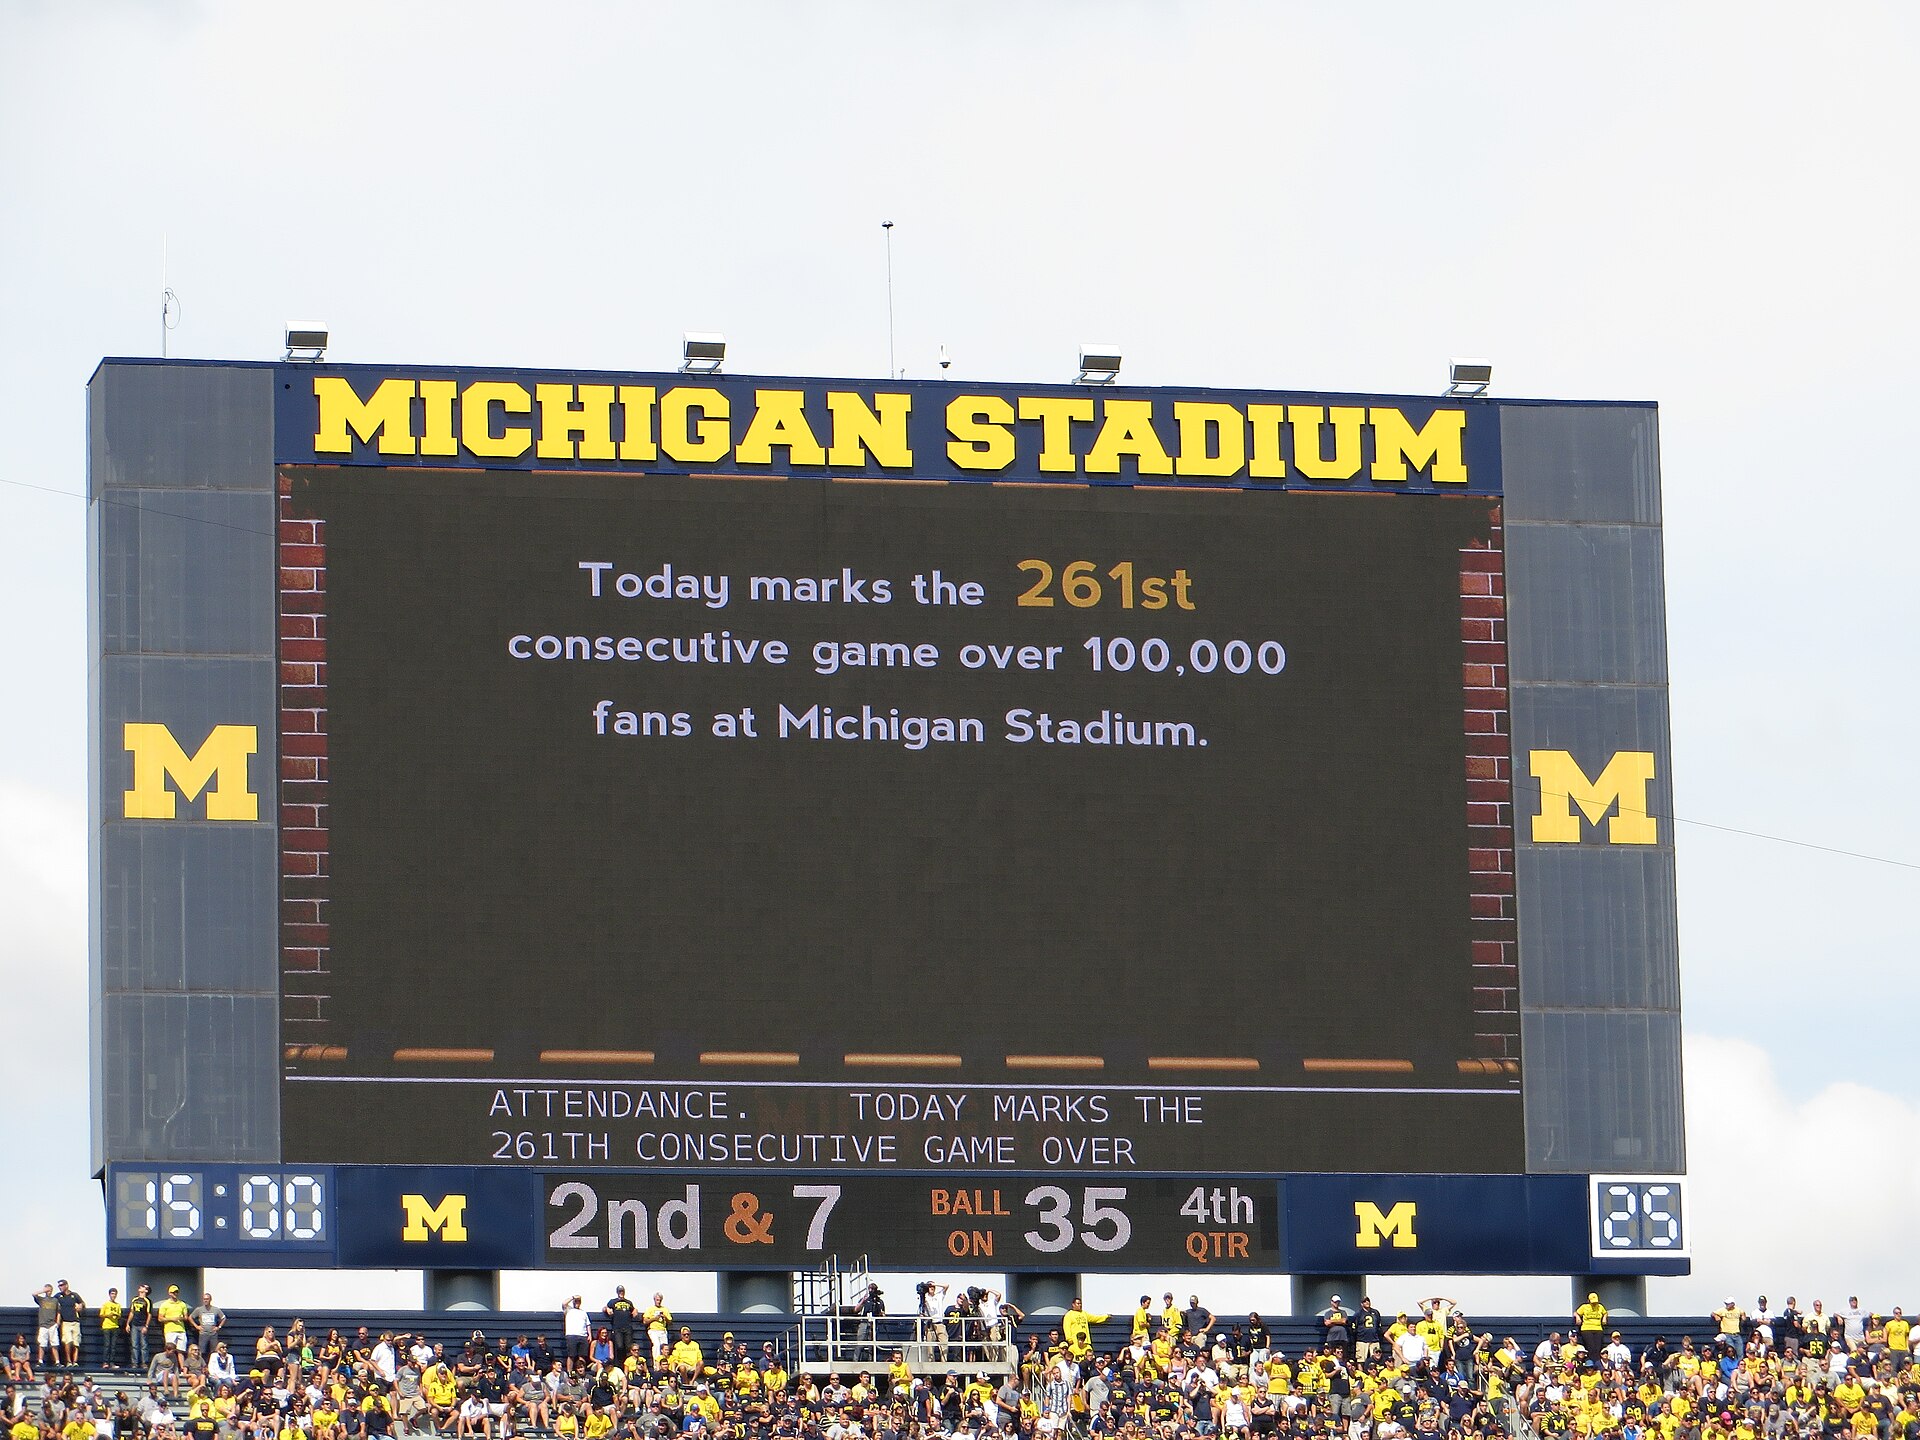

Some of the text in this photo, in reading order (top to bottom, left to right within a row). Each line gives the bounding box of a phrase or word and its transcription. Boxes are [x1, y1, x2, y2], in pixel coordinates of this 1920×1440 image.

[314, 378, 1467, 482] MICHIGAN STADIUM
[579, 560, 1195, 610] Today marks the 261st
[509, 631, 1285, 676] consecutive game over 100,000
[593, 700, 1207, 749] fans at Michigan Stadium.
[124, 723, 257, 820] M
[1530, 750, 1657, 844] M
[490, 1090, 1202, 1123] ATTENDANCE. TODAY MARKS THE
[492, 1132, 1135, 1164] 261TH CONSECUTIVE GAME OVER
[147, 1175, 321, 1238] 15:00
[403, 1195, 466, 1241] M
[550, 1182, 840, 1250] 2nd & 7
[932, 1190, 1009, 1215] BALL
[1024, 1186, 1130, 1252] 35
[1181, 1187, 1253, 1223] 4th
[1355, 1202, 1416, 1247] M
[1604, 1187, 1677, 1246] 25
[948, 1231, 992, 1256] ON
[1187, 1232, 1248, 1262] QTR
[1364, 1315, 1374, 1328] 2
[1809, 1341, 1823, 1355] 65
[1553, 1419, 1566, 1430] M
